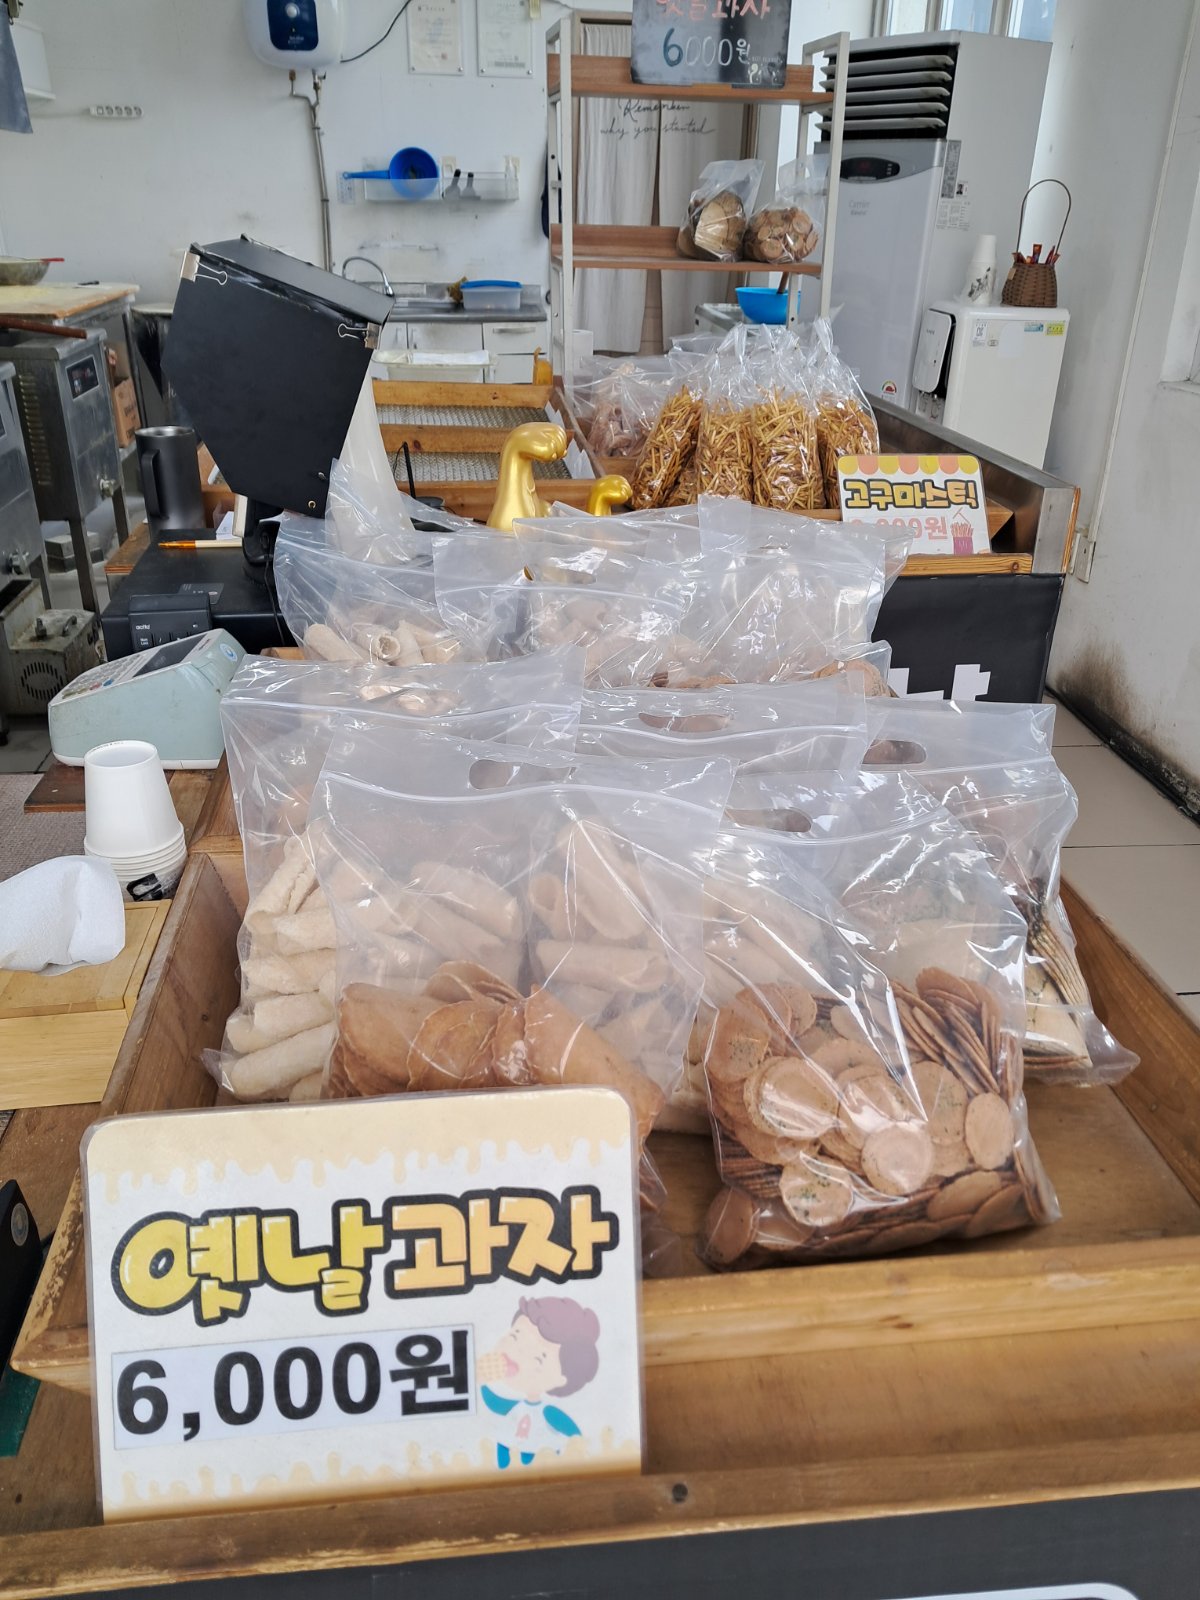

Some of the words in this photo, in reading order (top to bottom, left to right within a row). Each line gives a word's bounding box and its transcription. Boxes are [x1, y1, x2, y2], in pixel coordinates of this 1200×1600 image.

[663, 28, 750, 66] 6000원
[601, 117, 629, 140] why
[663, 117, 716, 135] started
[843, 479, 979, 510] 고구마스틱
[111, 1185, 619, 1327] 옛날과자
[117, 1330, 469, 1442] 6,000원
